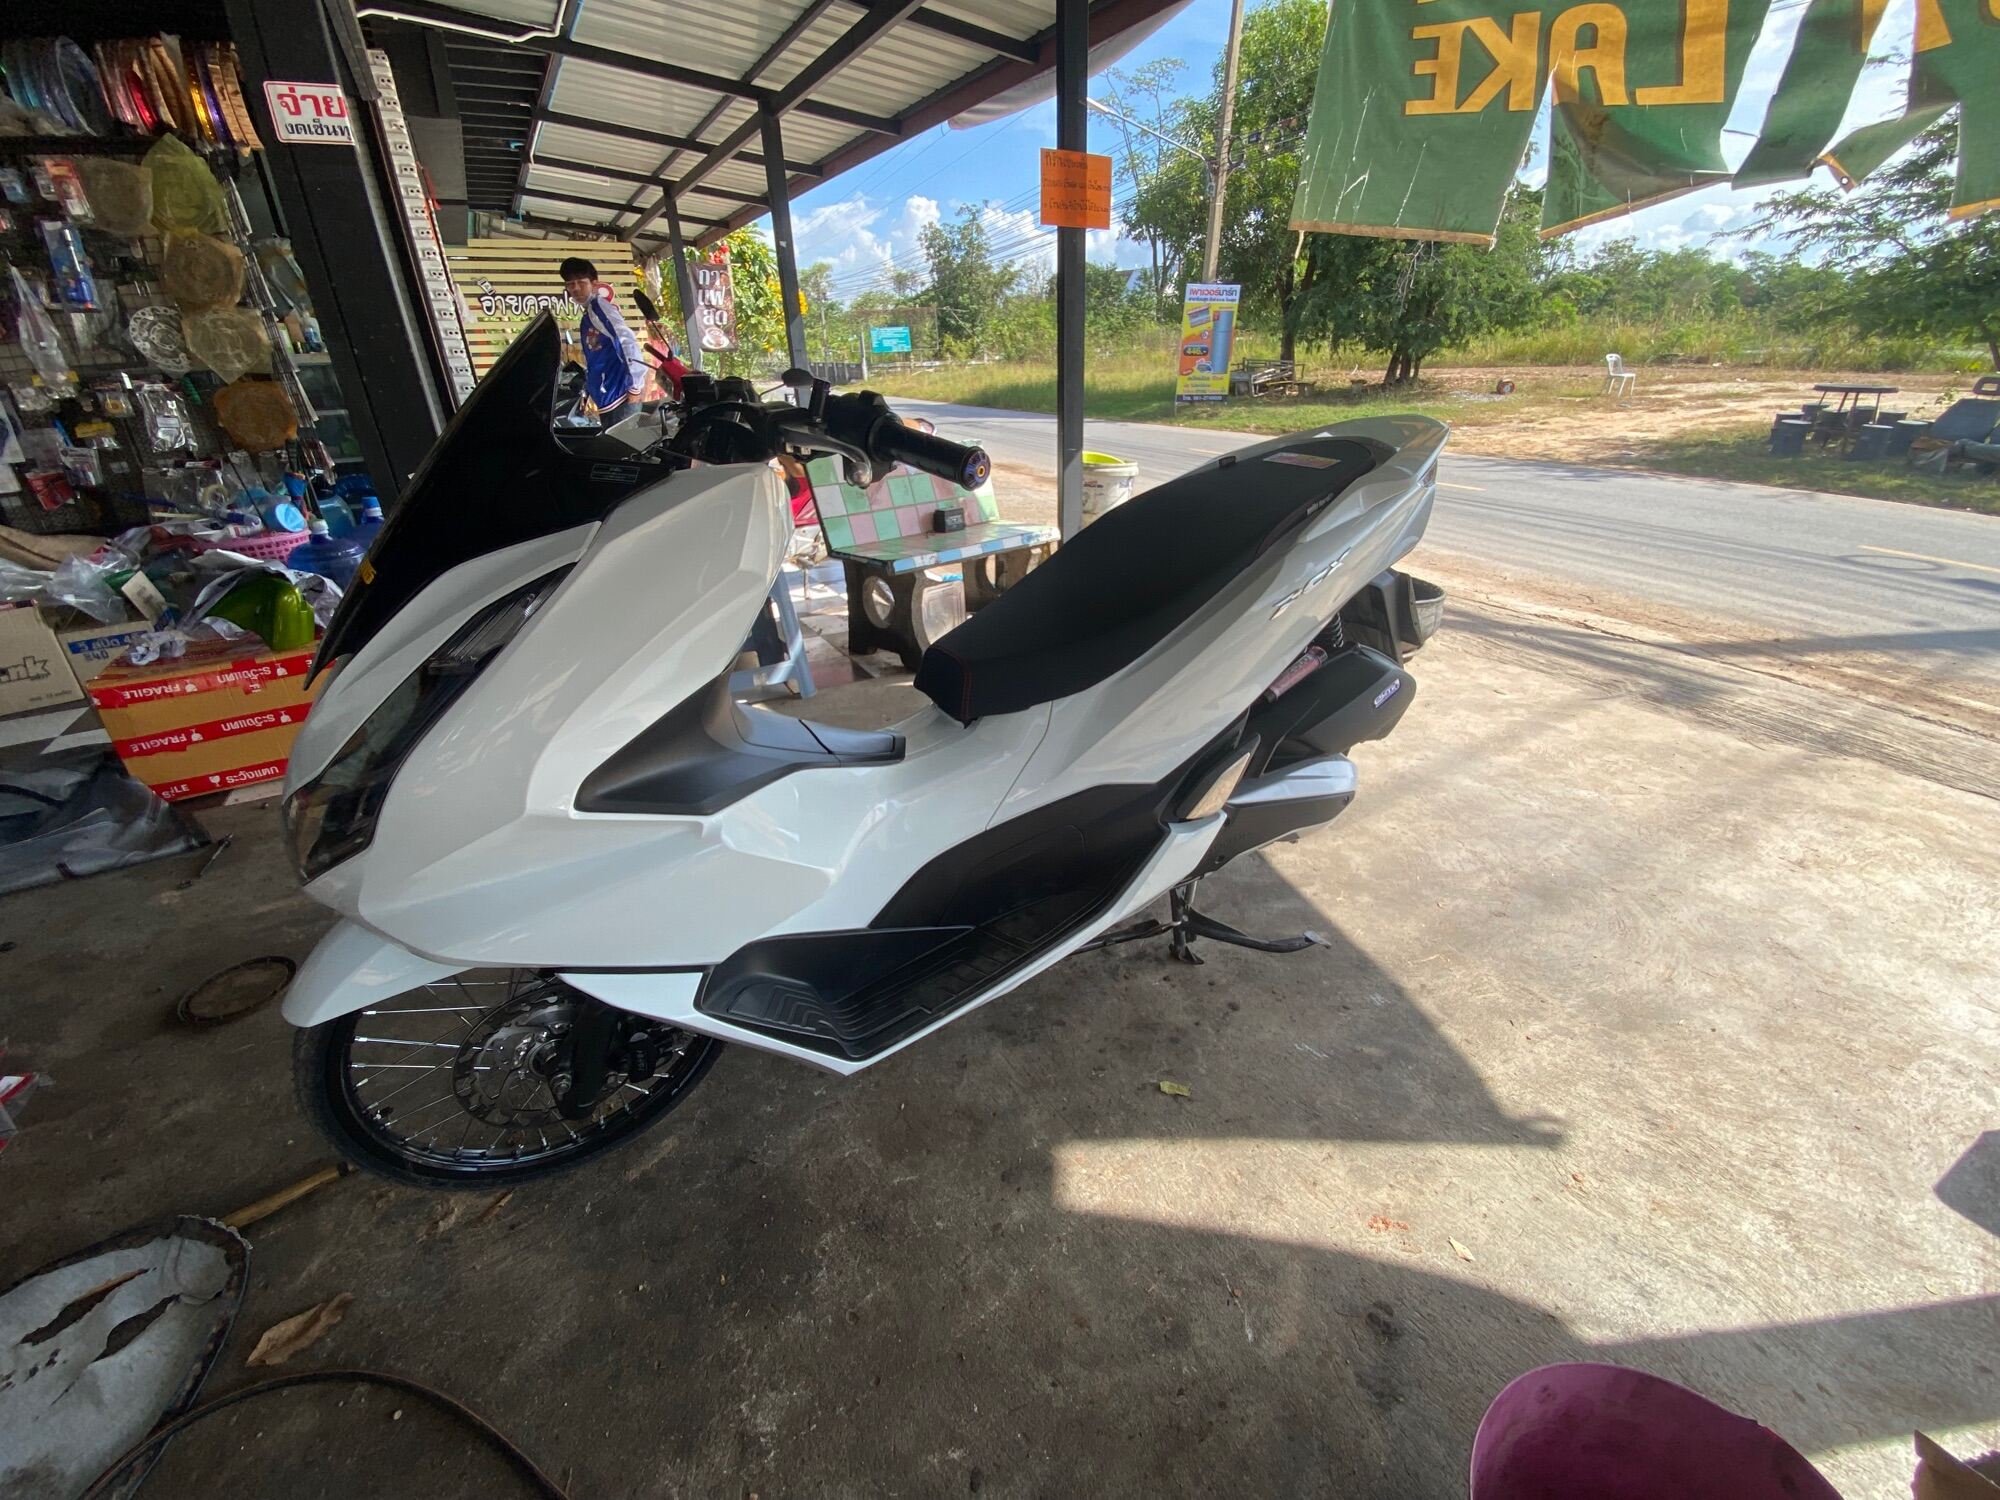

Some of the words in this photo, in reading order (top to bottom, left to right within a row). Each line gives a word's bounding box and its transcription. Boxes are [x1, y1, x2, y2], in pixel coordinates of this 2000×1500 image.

[276, 86, 347, 117] จ่าย
[123, 683, 181, 699] FRAGILE
[221, 713, 275, 732] ระวังแตก
[130, 733, 188, 752] FRAGILE
[225, 766, 279, 784] ระวังแตก
